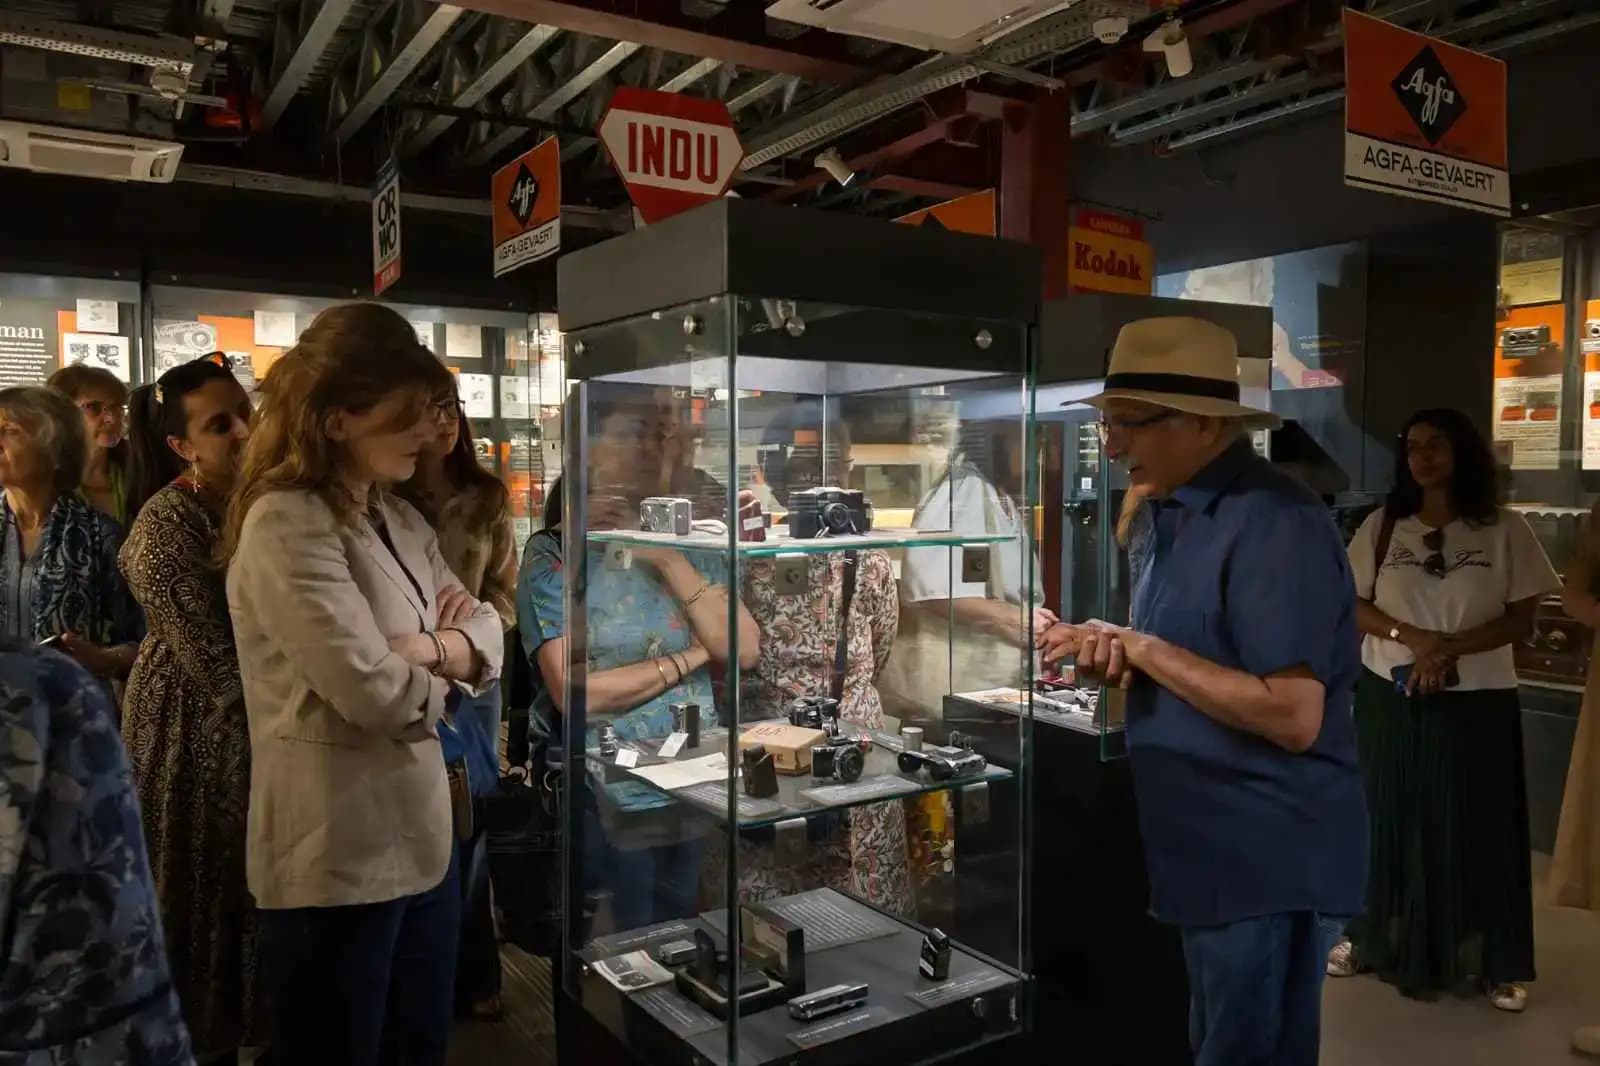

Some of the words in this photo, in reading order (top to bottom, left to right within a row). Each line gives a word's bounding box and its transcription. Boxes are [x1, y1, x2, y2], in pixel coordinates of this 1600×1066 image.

[1400, 66, 1455, 126] Agfa
[627, 121, 719, 186] INDU
[1362, 145, 1496, 193] AGFA-GEVAERT
[378, 186, 396, 226] OR
[378, 220, 397, 258] WO
[1074, 240, 1142, 281] Kodak
